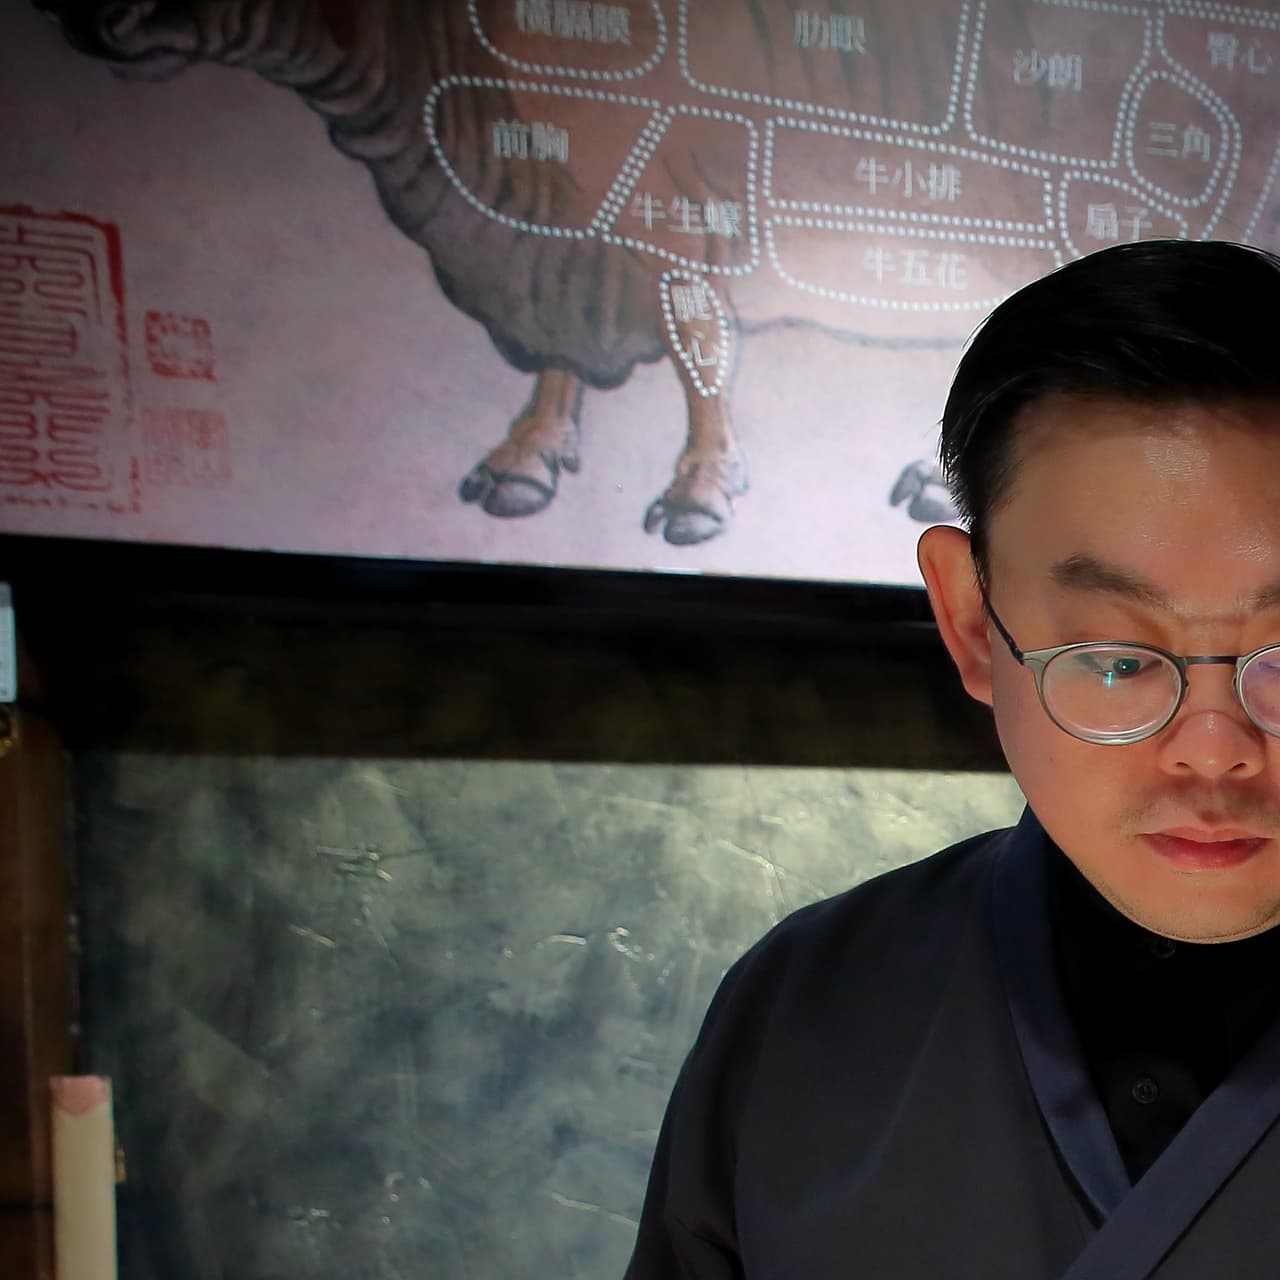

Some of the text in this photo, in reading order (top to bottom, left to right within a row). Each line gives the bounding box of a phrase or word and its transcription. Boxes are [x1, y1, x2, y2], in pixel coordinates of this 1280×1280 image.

[1012, 48, 1083, 91] 沙朗
[492, 118, 569, 163] 前胸
[1144, 121, 1211, 163] 三角
[855, 156, 962, 203] 牛小排
[863, 247, 968, 290] 牛五花
